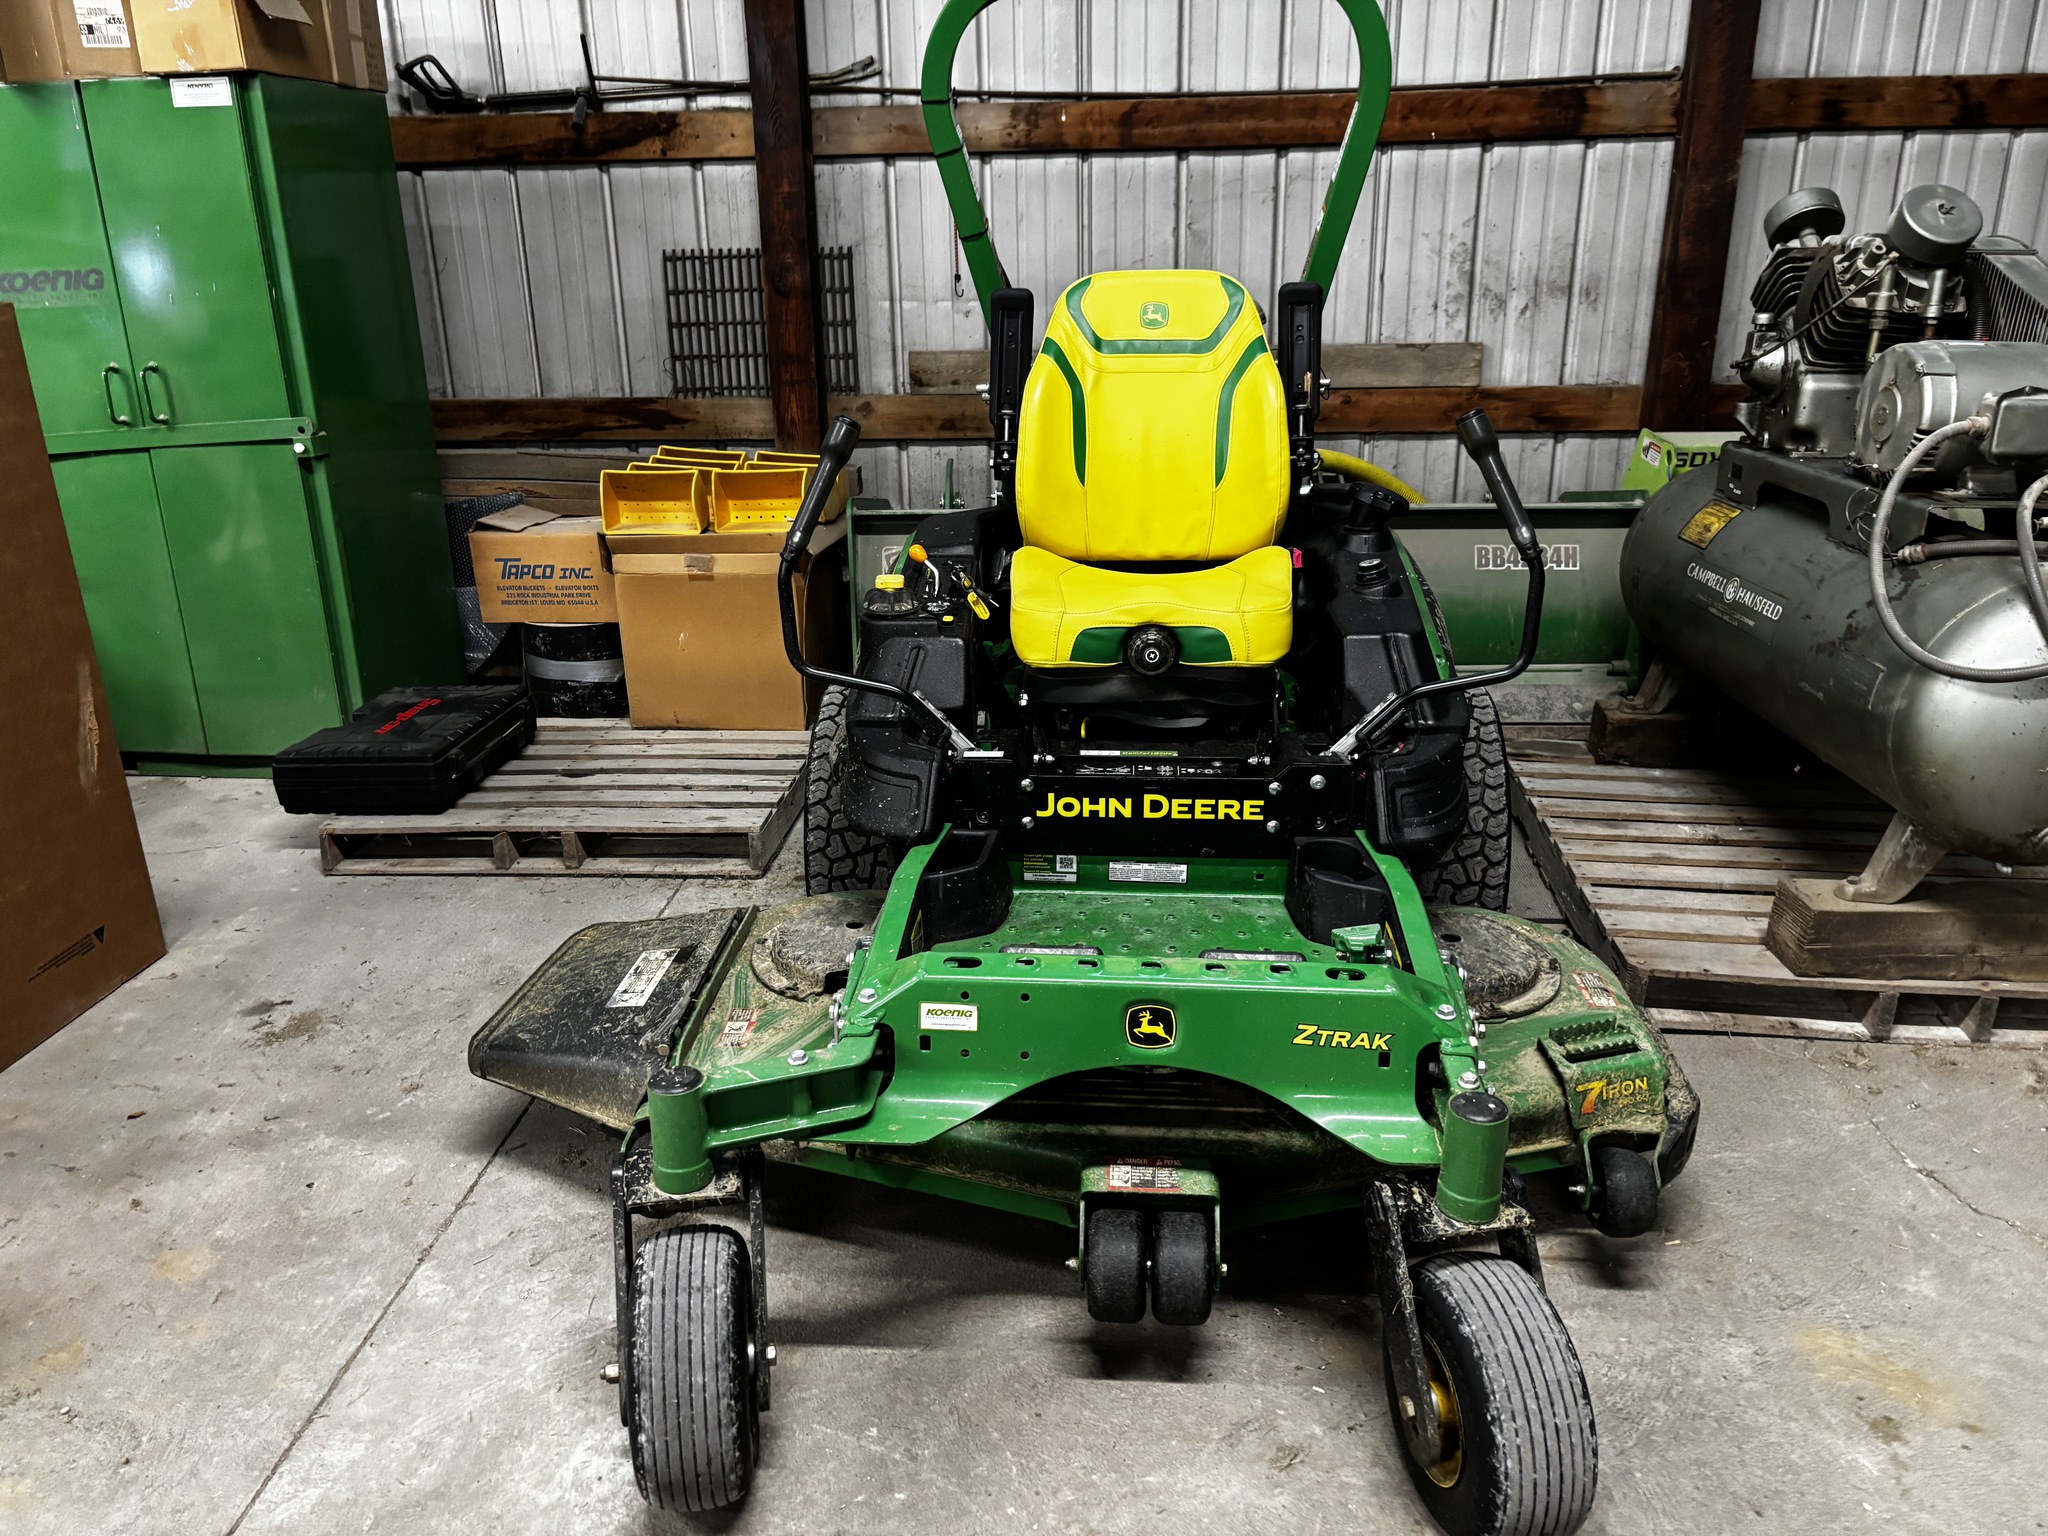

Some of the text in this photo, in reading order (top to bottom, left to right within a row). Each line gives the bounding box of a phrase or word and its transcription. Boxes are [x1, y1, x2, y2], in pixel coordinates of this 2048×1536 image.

[494, 557, 594, 580] TAPCO INC.
[1686, 562, 1728, 593] CAMPBELL
[1735, 586, 1783, 621] HAUSFELD
[1036, 793, 1265, 821] JOHN DEERE
[1292, 1023, 1394, 1051] ZTRAK
